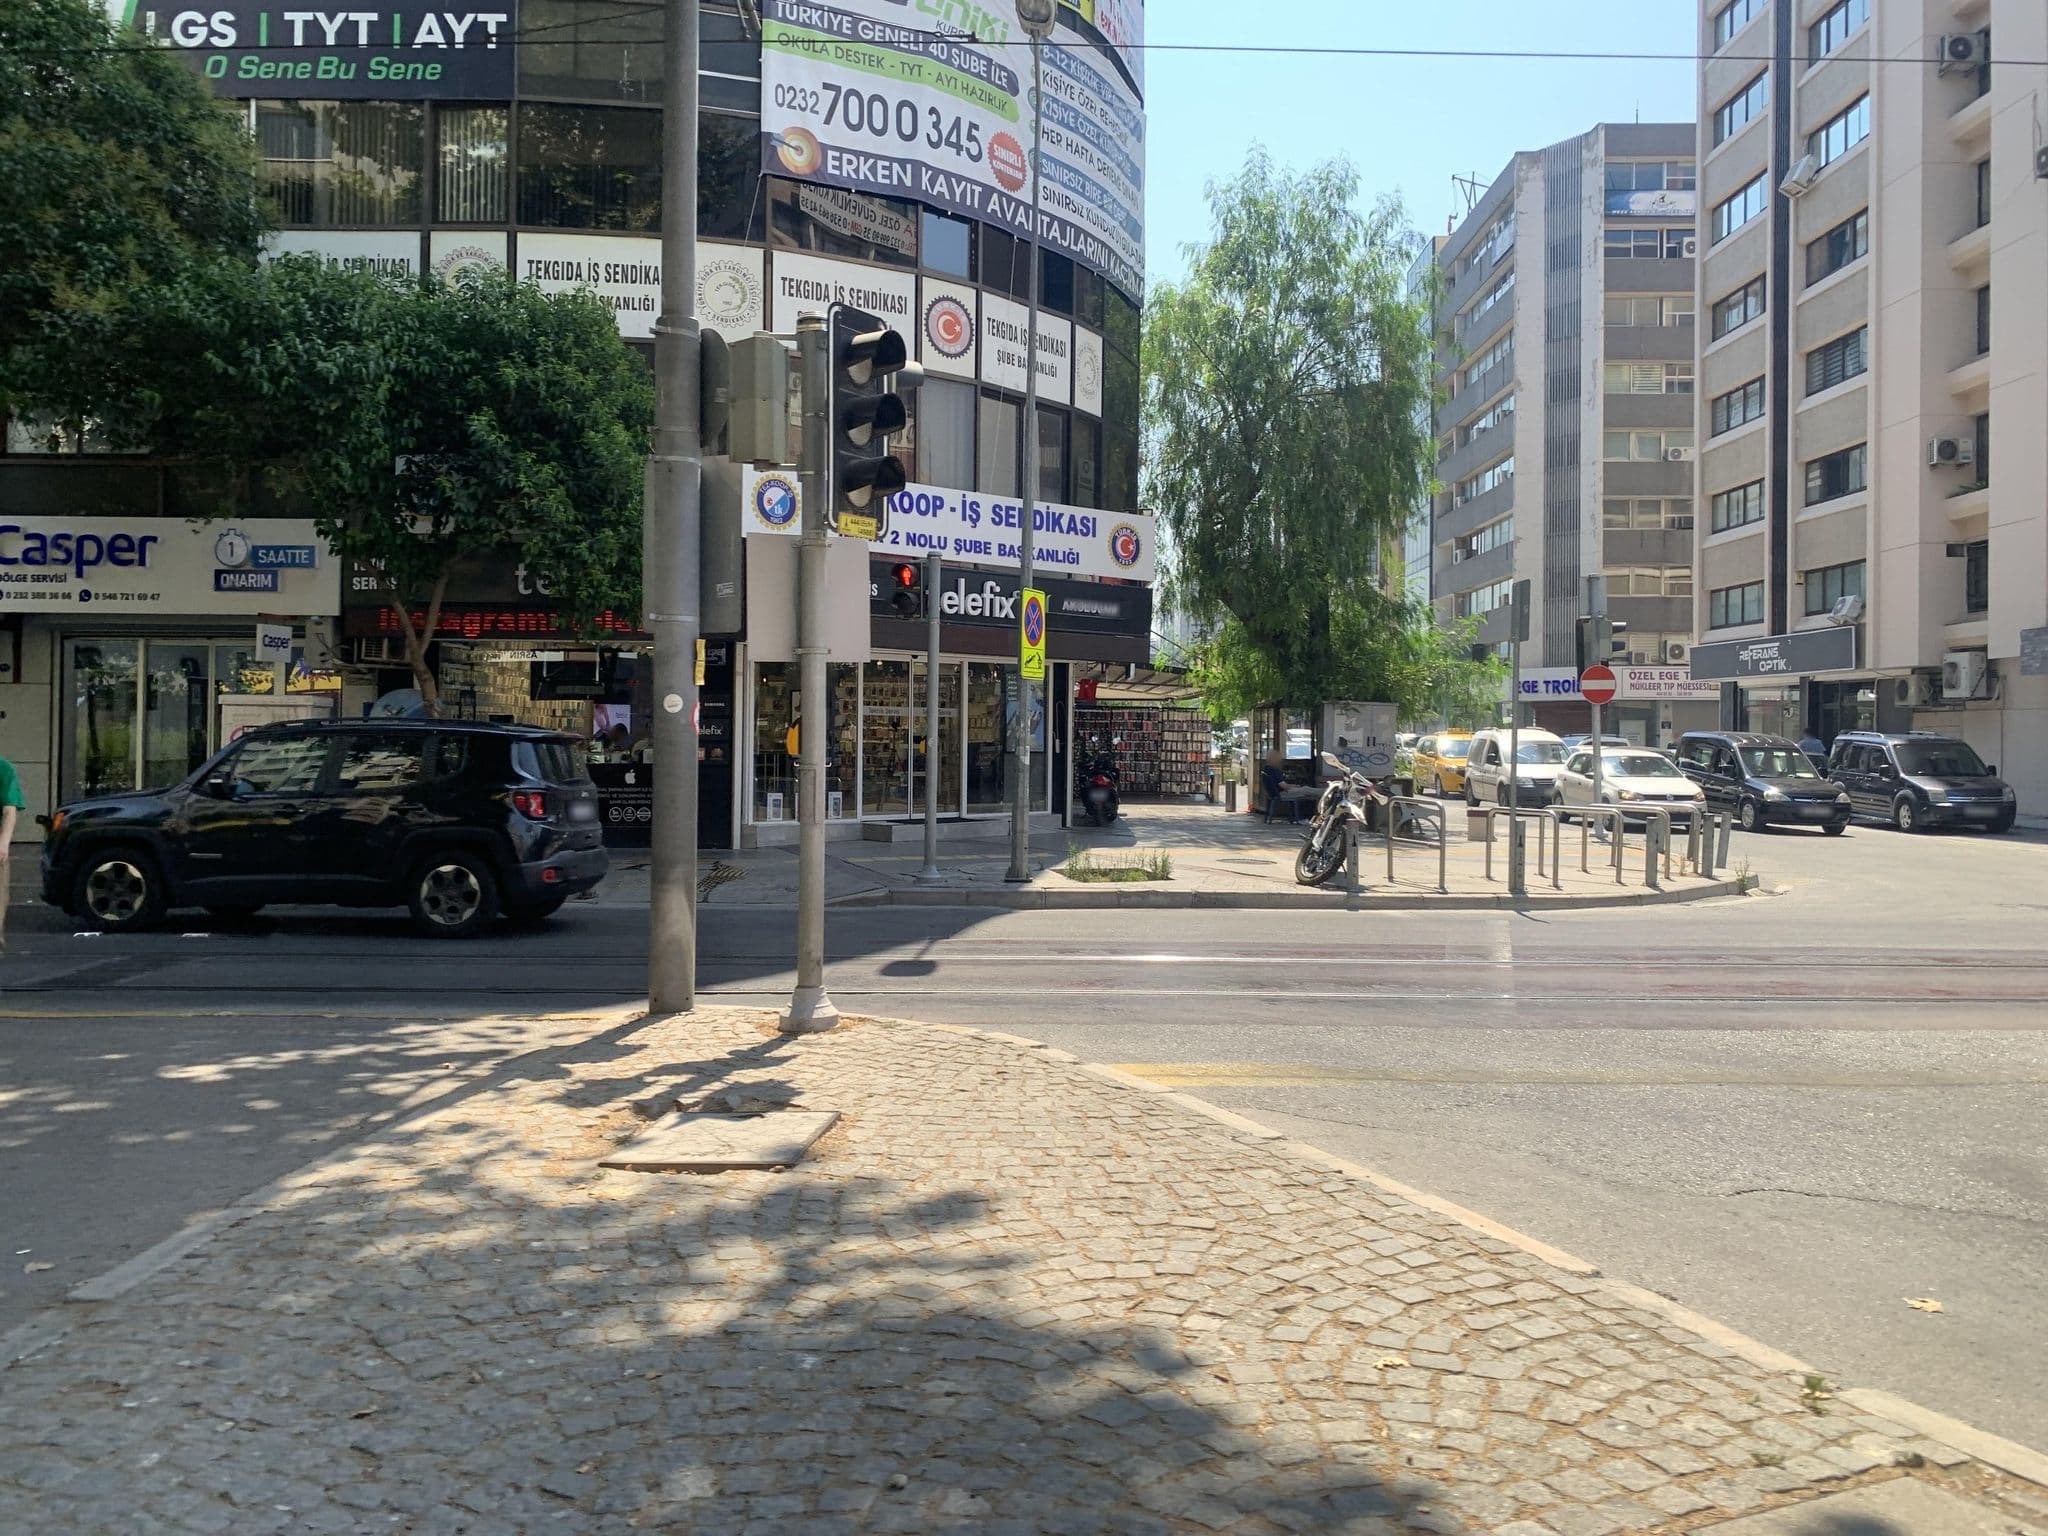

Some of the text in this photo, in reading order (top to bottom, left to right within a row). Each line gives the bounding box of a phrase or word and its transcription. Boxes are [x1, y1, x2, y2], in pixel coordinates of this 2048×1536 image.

[145, 11, 237, 48] LGS
[283, 11, 378, 48] TYT
[411, 13, 507, 49] AYT
[776, 0, 1008, 89] TÜRKİYE GENELİ 40 ŞUBE İLE
[205, 55, 442, 80] O Sene Bu Sene
[1043, 45, 1068, 69] 8-12
[777, 32, 830, 56] OKULA
[834, 45, 885, 70] DESTEK
[900, 61, 923, 77] TYT
[936, 71, 958, 90] AYT
[961, 82, 1008, 114] HAZIRLIK
[1042, 69, 1075, 101] KİŞİYE
[1077, 87, 1098, 117] ÖZEL
[775, 82, 983, 163] 0232 700 0 345
[1041, 97, 1077, 127] KİŞİYE
[1042, 124, 1063, 148] HER
[1066, 136, 1095, 169] HAFTA
[826, 149, 912, 187] ERKEN
[921, 166, 982, 209] KAYIT
[527, 257, 661, 288] TEKGIDA İŞ SENDİKA
[781, 276, 830, 303] TEKGIDA
[849, 287, 908, 315] SENDİKASI
[986, 316, 1018, 345] TEKGIDA
[1020, 324, 1028, 351] İŞ
[1035, 331, 1067, 359] ENDİKASI
[996, 349, 1058, 379] ŞUBE BAANLIĞI
[961, 493, 981, 528] İŞ
[0, 525, 158, 578] Casper
[258, 550, 310, 563] SAATTE
[890, 530, 900, 545] 2
[906, 531, 948, 551] NOLU
[954, 538, 992, 556] ŞUBE
[0, 571, 67, 583] ÖLGE SERVİSİ
[220, 573, 272, 588] ONARIM
[925, 578, 1016, 619] elefix
[262, 634, 290, 652] Casper
[1739, 643, 1780, 670] REFERANS
[1629, 669, 1656, 681] ÖZEL
[1659, 671, 1681, 681] EGE
[1759, 656, 1787, 672] OPTİK
[1629, 681, 1662, 692] NÜKLEER
